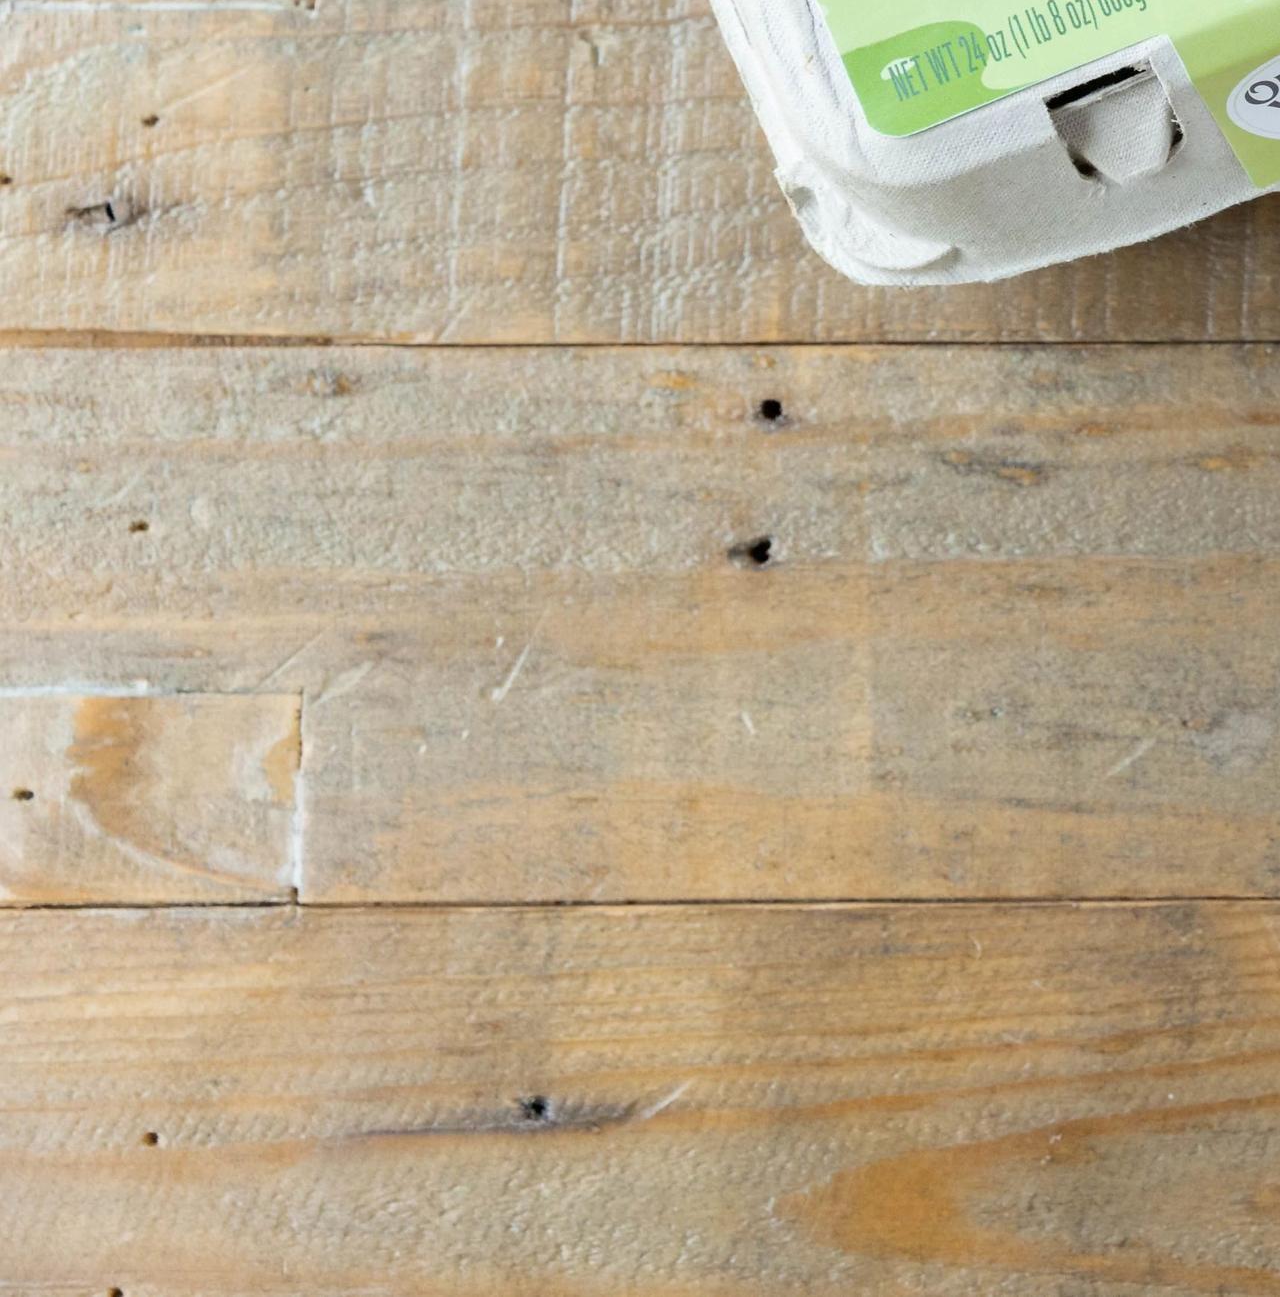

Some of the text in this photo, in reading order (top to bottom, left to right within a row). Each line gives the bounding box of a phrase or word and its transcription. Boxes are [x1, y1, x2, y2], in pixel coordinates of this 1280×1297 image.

[886, 57, 928, 101] NET
[924, 40, 960, 83] WT
[956, 32, 990, 73] 24
[983, 31, 1012, 61] oz
[1008, 15, 1030, 59] (1
[1025, 7, 1052, 44] lb
[1047, 0, 1066, 35] 8
